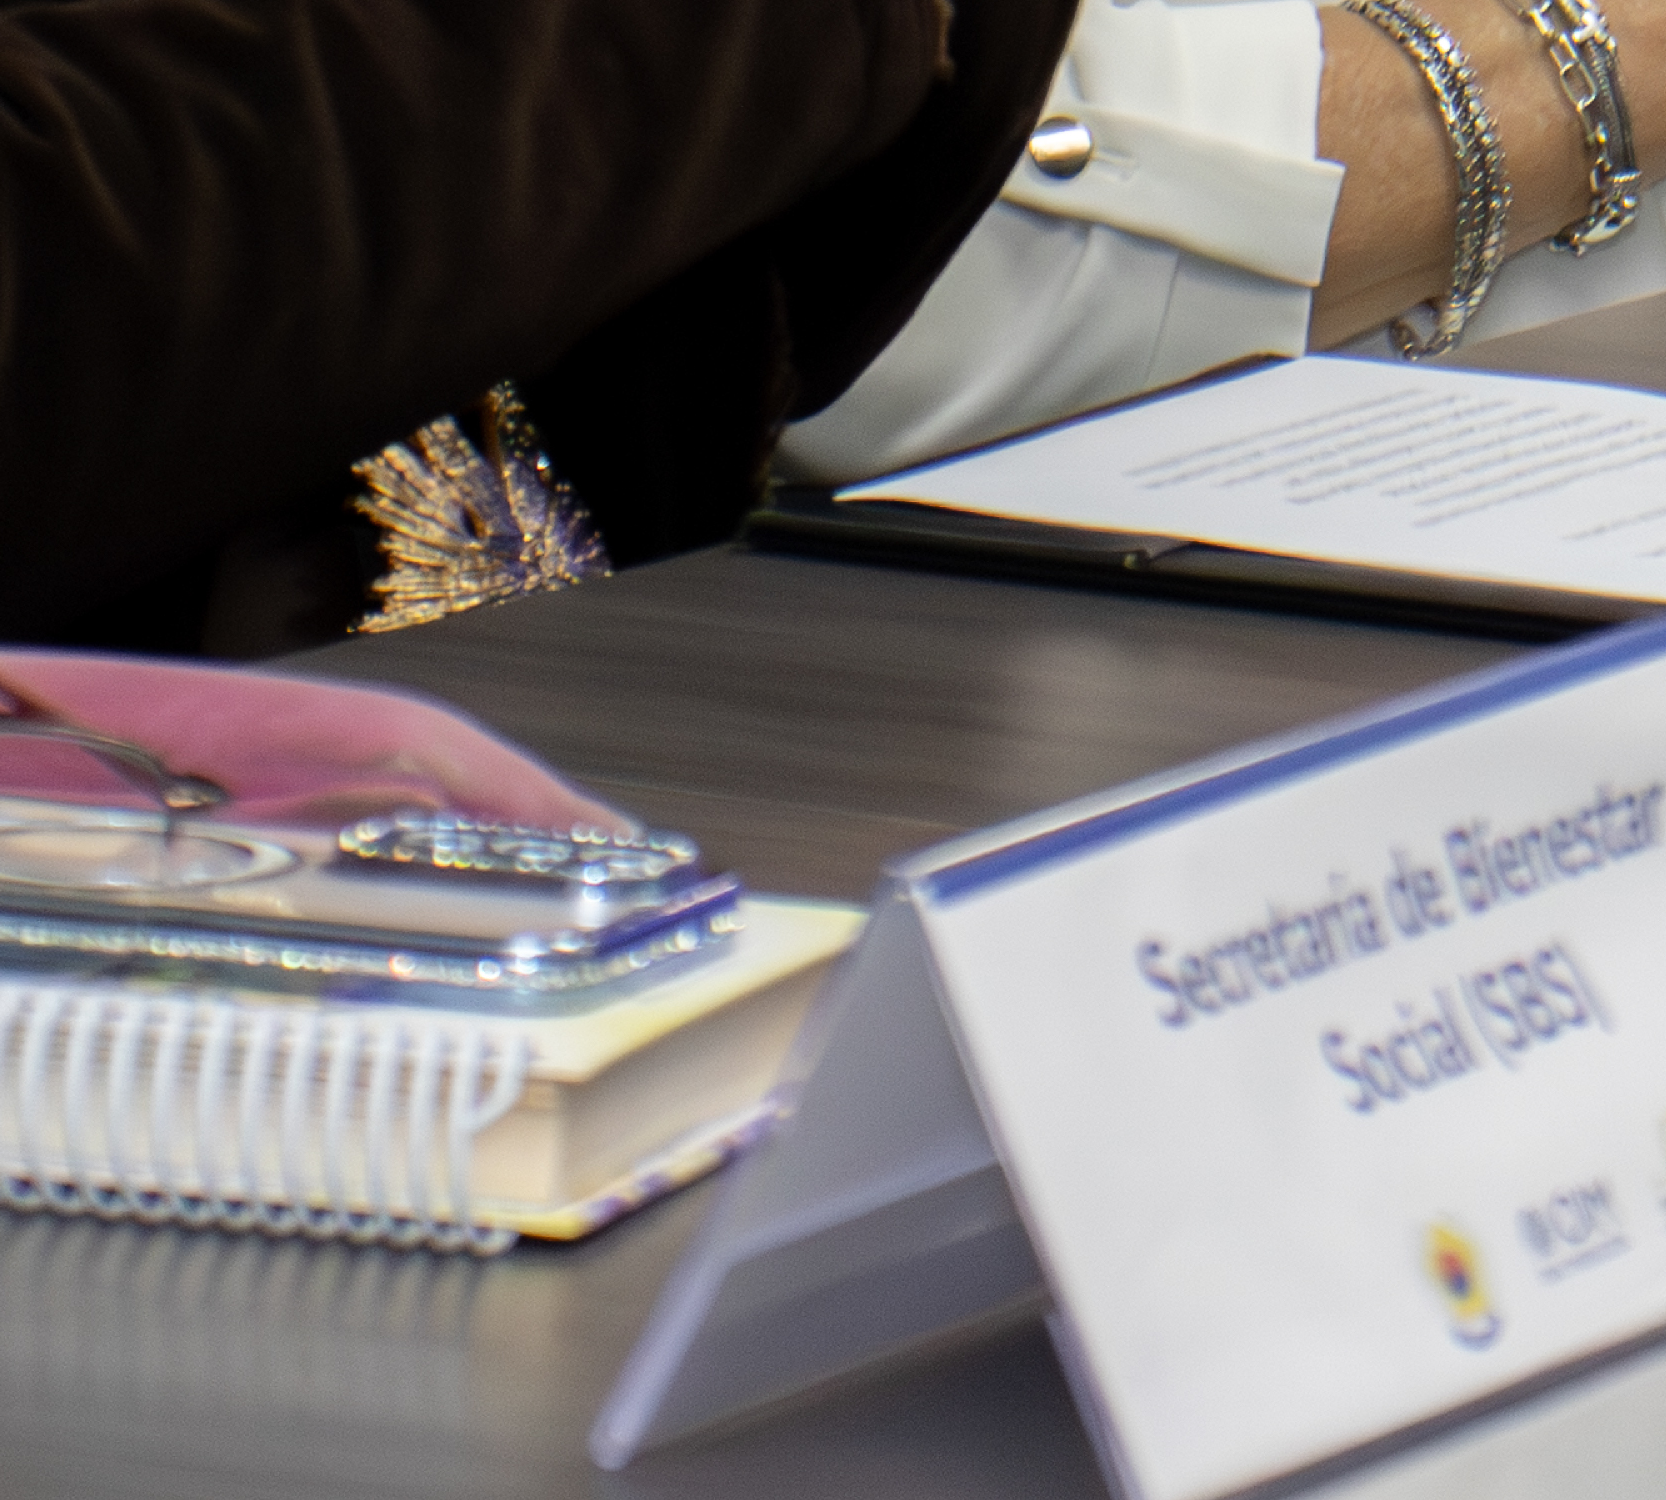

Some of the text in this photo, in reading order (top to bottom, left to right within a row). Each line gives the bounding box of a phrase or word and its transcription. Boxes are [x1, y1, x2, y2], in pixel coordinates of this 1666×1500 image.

[1384, 845, 1455, 939] de
[1443, 782, 1666, 916] Bienestar
[1320, 940, 1618, 1115] Social (SBS)
